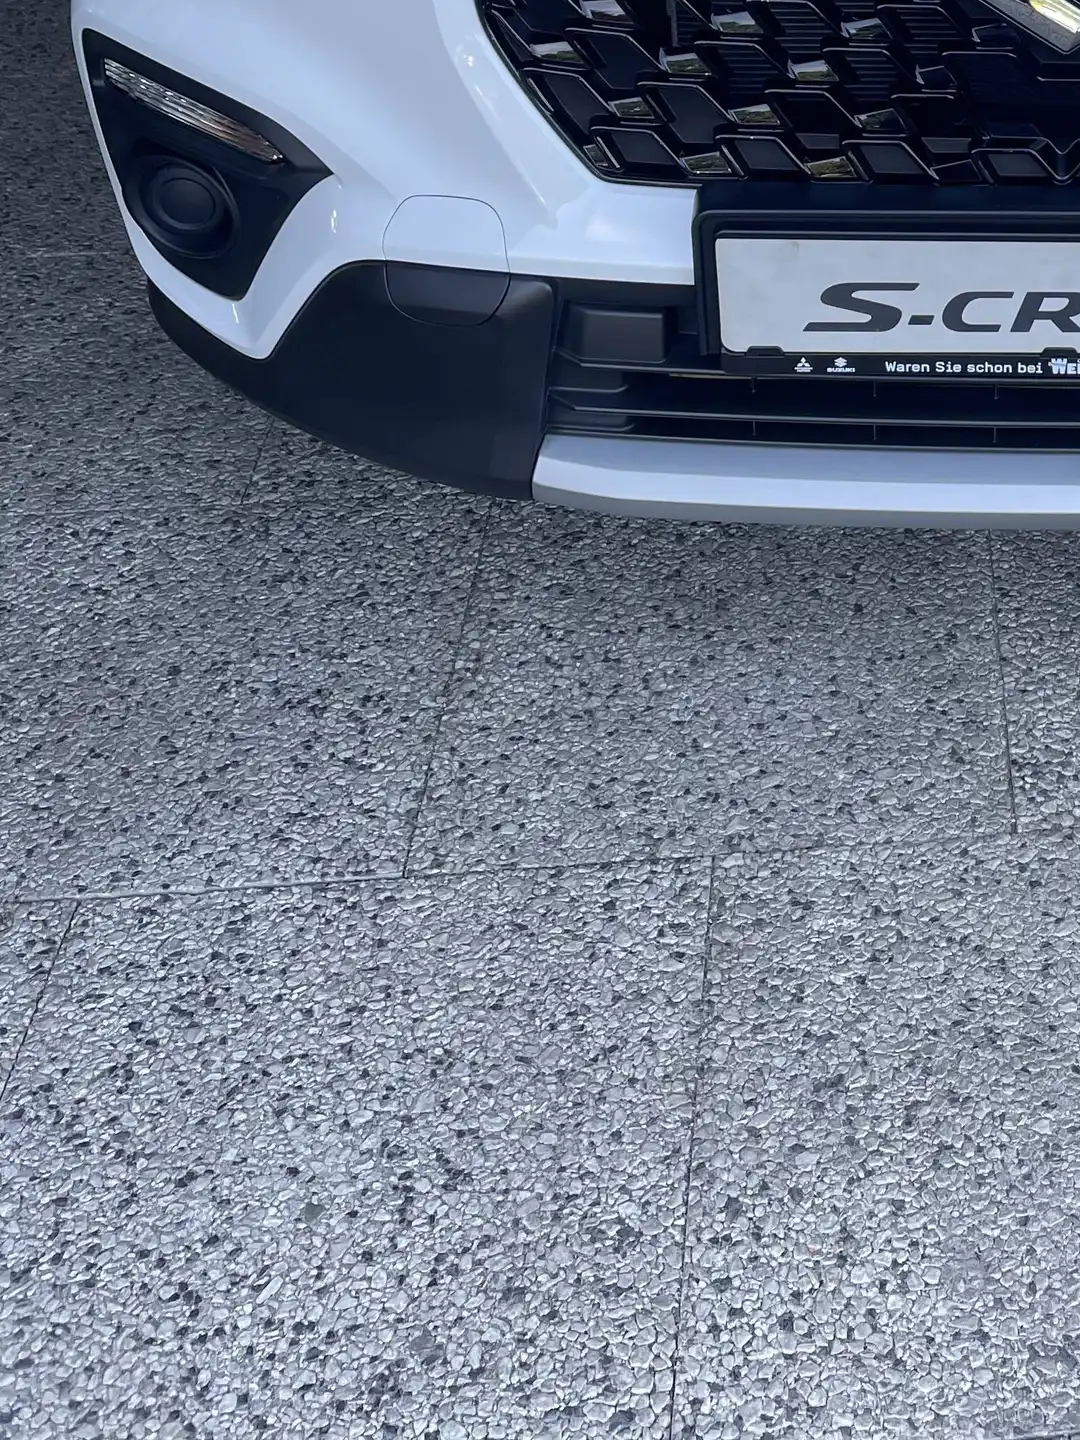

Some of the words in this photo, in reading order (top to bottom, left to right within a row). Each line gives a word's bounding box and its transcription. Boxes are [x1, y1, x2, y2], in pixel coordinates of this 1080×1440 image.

[885, 361, 930, 373] Waren
[935, 361, 962, 374] Sie
[966, 361, 1012, 374] schon
[1017, 363, 1044, 375] bei
